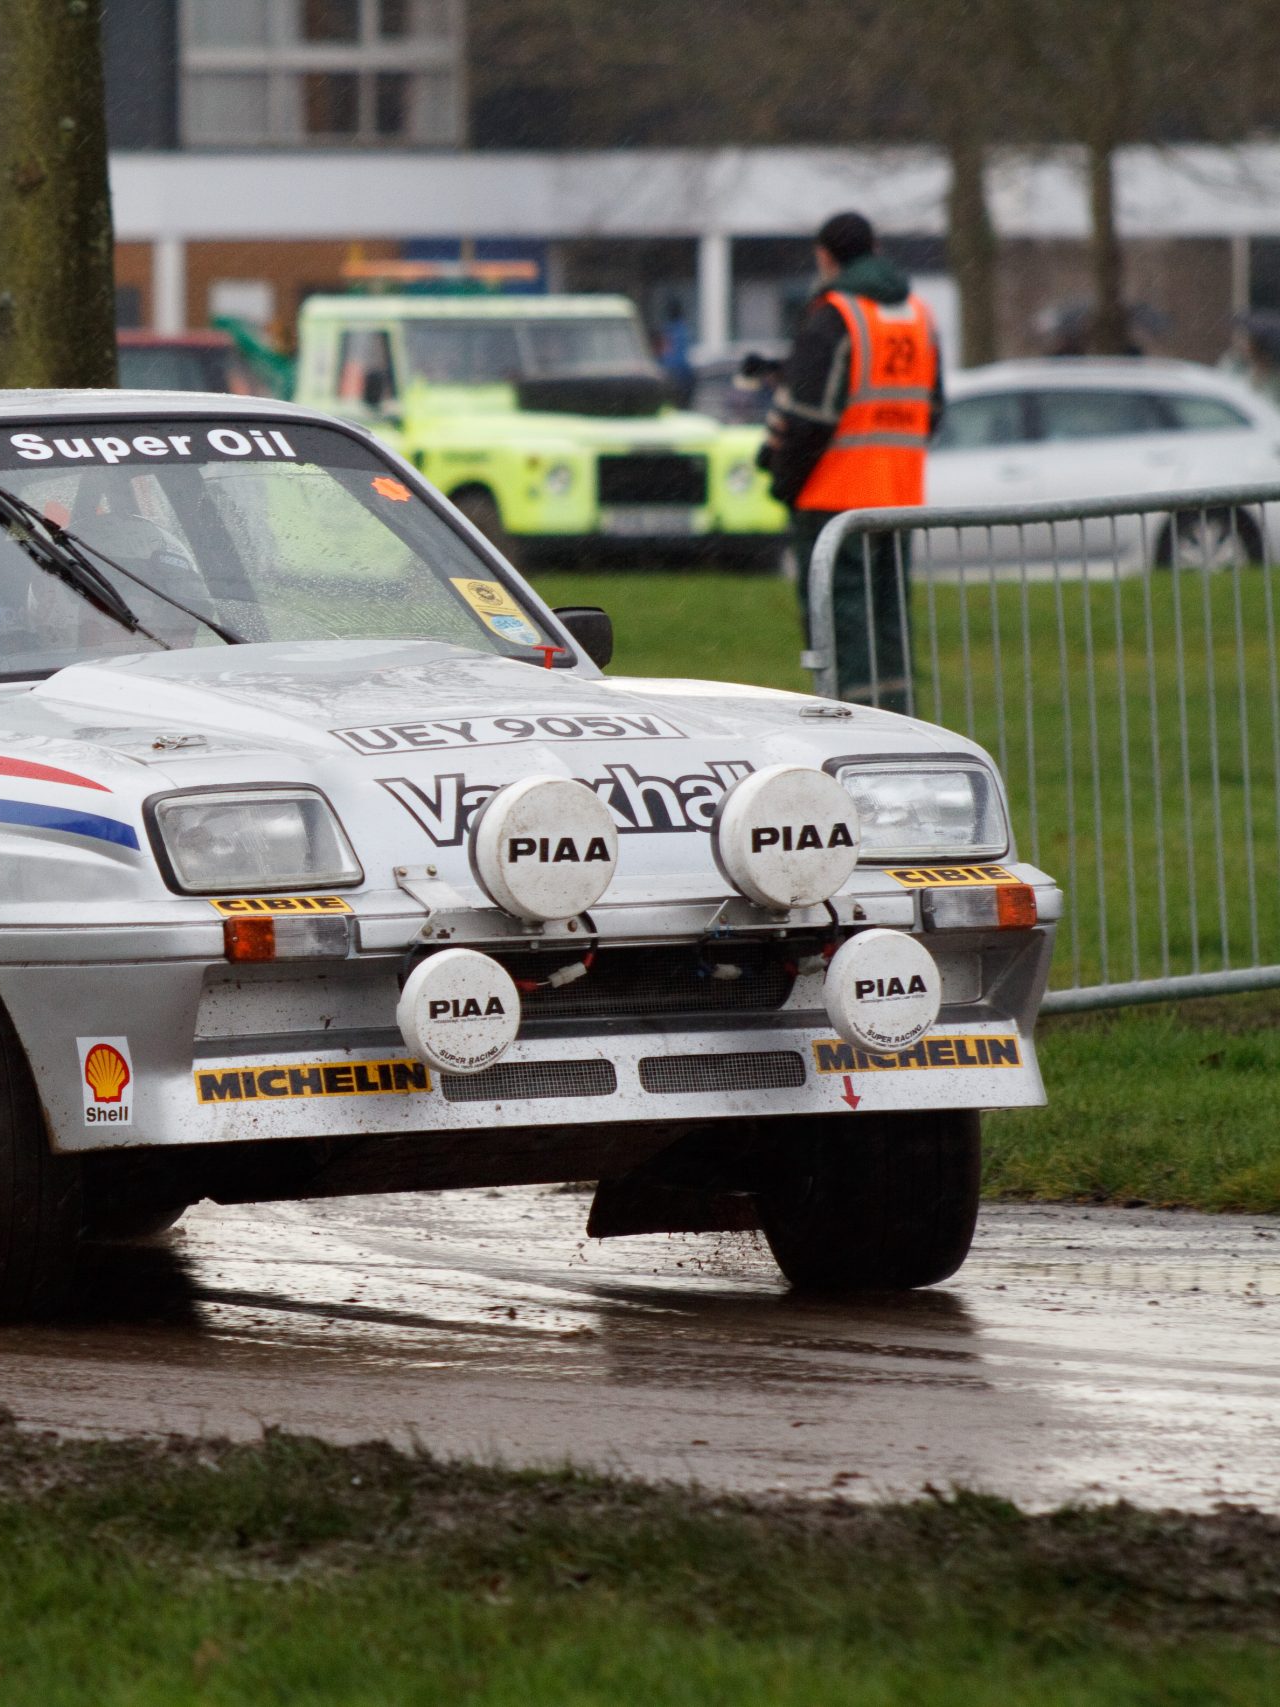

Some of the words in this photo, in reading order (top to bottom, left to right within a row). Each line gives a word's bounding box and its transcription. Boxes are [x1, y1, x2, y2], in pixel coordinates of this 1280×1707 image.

[10, 432, 191, 464] Super
[206, 428, 297, 457] Oil
[345, 721, 486, 750] UEY
[493, 716, 661, 739] 905V
[374, 760, 756, 848] Vaxha
[508, 837, 611, 863] PIAA
[751, 822, 854, 853] PIAA
[891, 866, 1011, 883] CIBIE
[216, 897, 347, 912] CIBIE
[855, 975, 927, 1000] PIAA
[428, 996, 506, 1019] PIAA
[866, 1029, 892, 1043] SUPER
[894, 1023, 923, 1043] RACING
[439, 1048, 467, 1065] SUPER
[468, 1045, 499, 1065] RACING
[198, 1063, 428, 1101] MICHELIN
[86, 1106, 128, 1122] Shell
